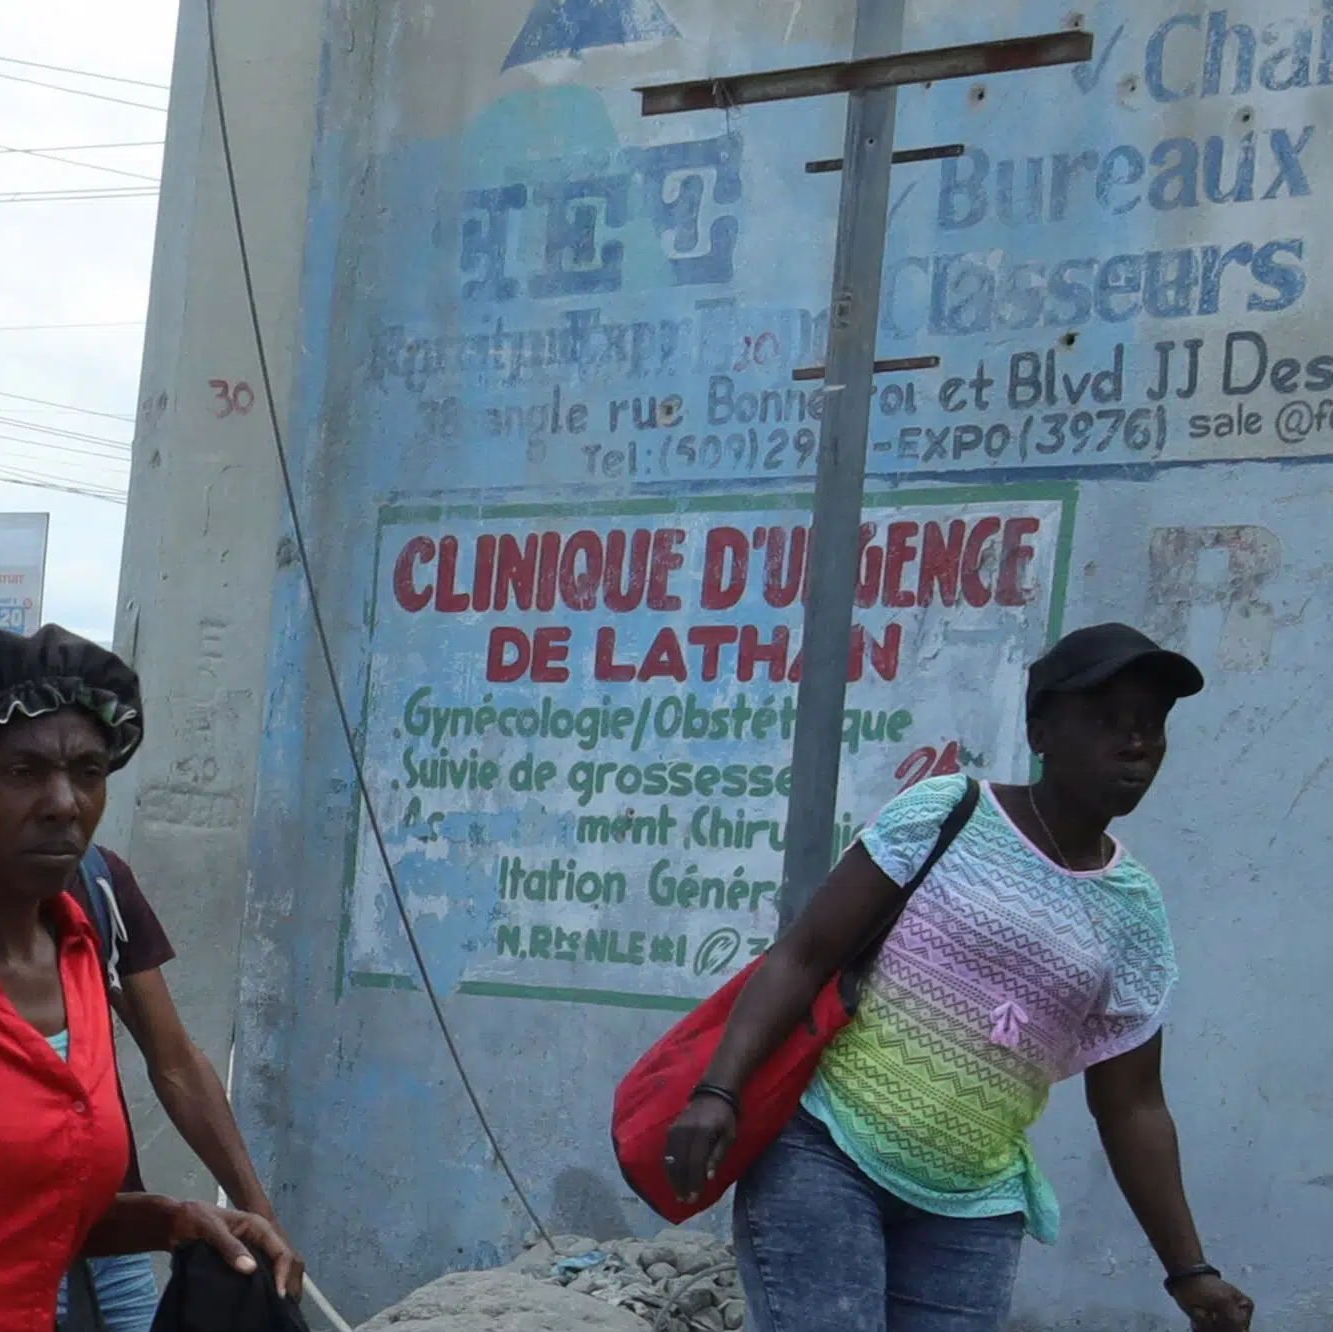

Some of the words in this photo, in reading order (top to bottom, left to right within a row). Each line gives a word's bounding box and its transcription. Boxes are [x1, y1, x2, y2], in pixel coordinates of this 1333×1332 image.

[936, 125, 1314, 232] Bureaux
[208, 379, 255, 419] 30
[608, 395, 684, 432] rue
[938, 360, 994, 412] et
[1007, 343, 1124, 411] Blvd
[1146, 338, 1204, 401] JJ
[1188, 402, 1263, 439] sale
[393, 529, 686, 613] CLINIQUE
[701, 516, 1041, 611] D'UGENCE
[486, 626, 573, 682] DE
[509, 752, 557, 793] de
